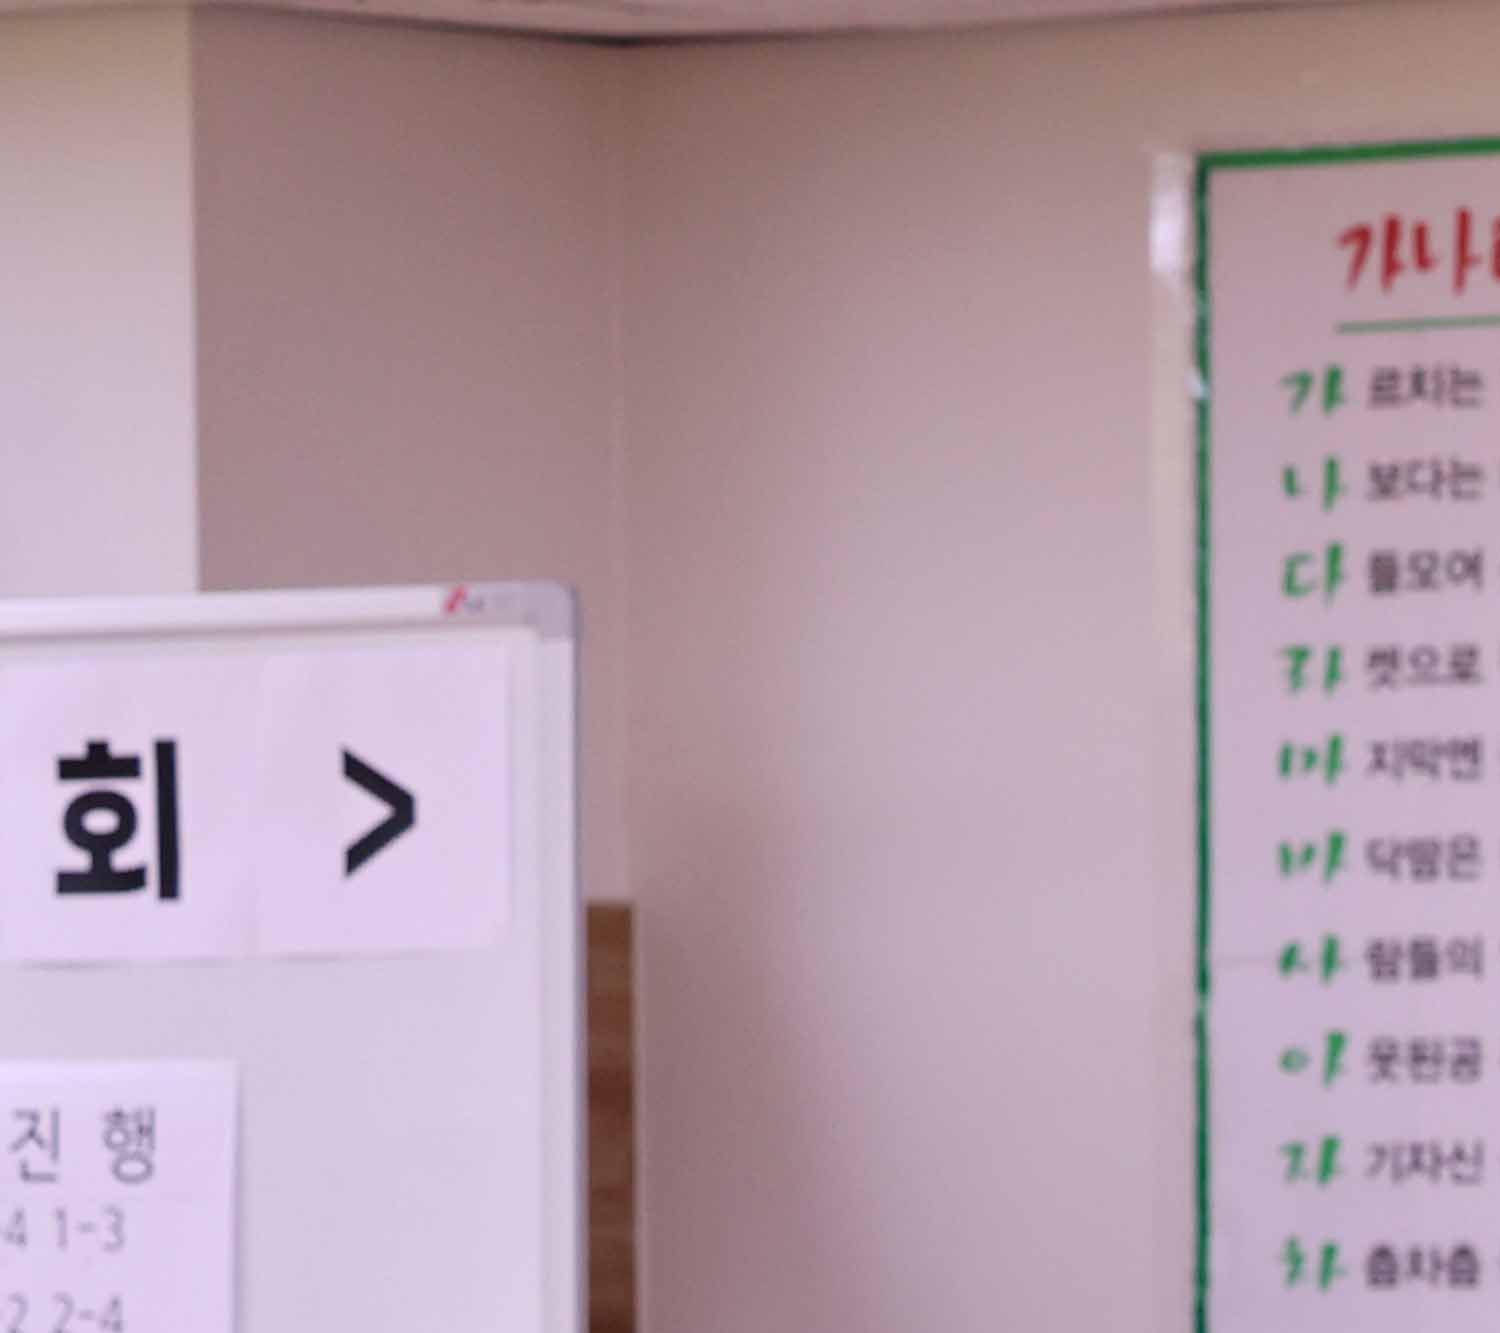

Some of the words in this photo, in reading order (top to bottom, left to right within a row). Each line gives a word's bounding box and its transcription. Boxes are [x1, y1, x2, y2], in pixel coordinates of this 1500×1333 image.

[1368, 364, 1484, 409] 르치는
[1366, 457, 1484, 501] 보다는
[1368, 550, 1483, 596] 들모여
[1364, 644, 1481, 690] 켓으로
[1367, 736, 1484, 781] 지막엔
[56, 740, 180, 902] 회
[1364, 936, 1483, 982] 람들의
[1365, 1140, 1484, 1185] 기자신
[55, 1205, 125, 1251] 1-3
